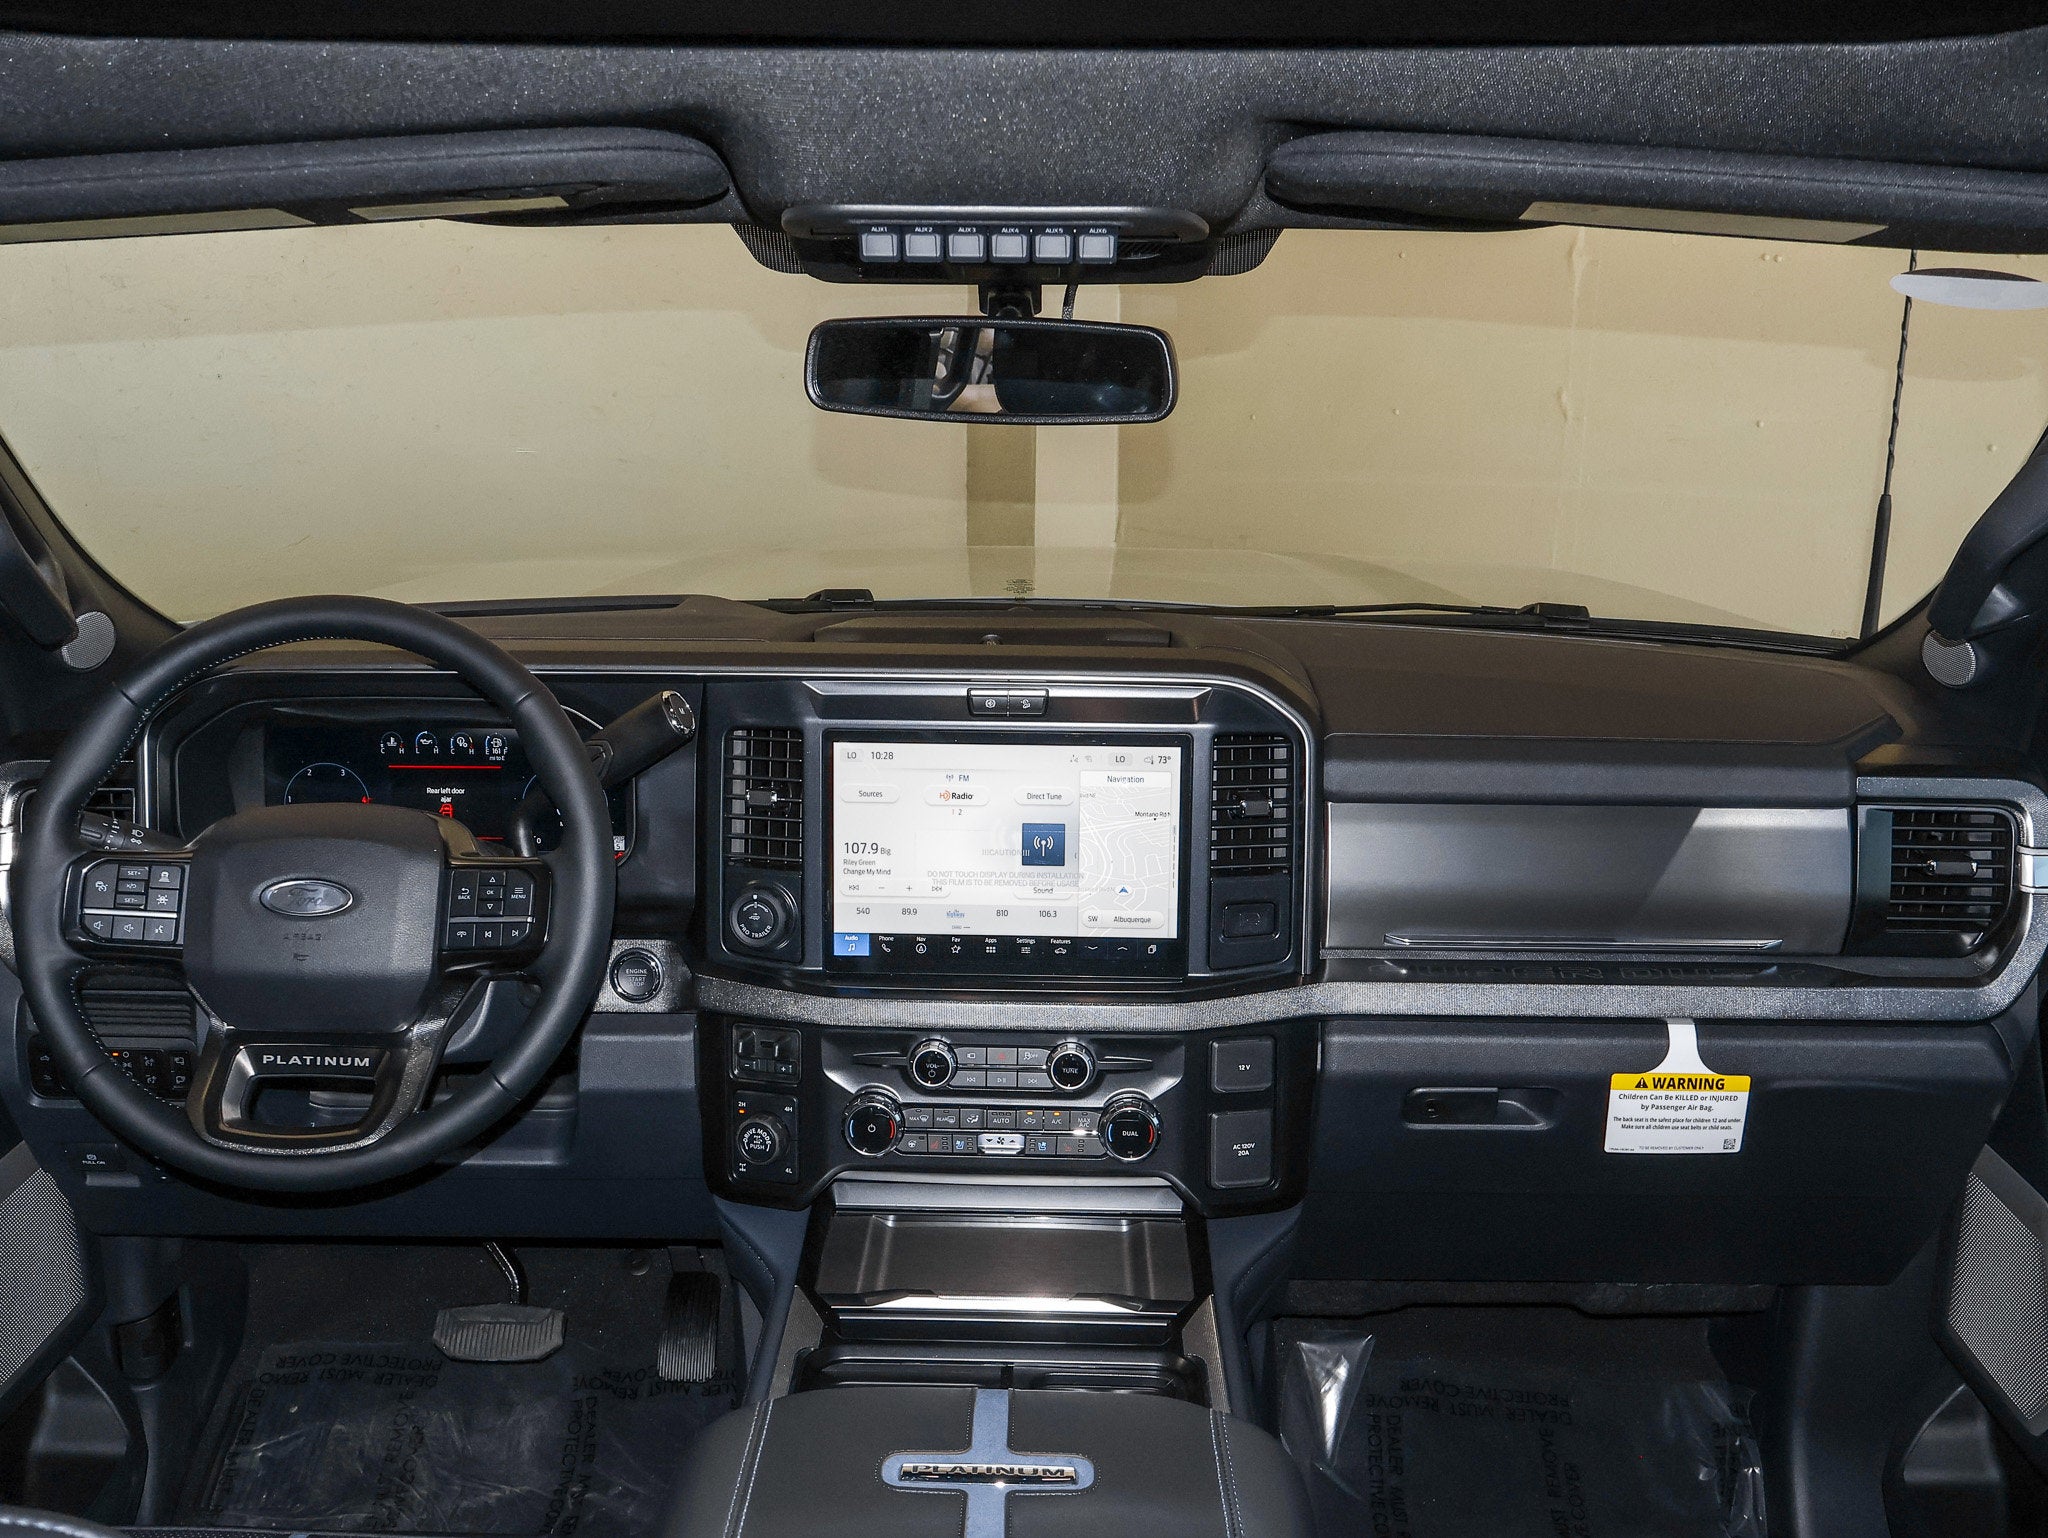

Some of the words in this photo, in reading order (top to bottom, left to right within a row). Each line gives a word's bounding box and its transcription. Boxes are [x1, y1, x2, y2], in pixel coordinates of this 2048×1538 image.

[870, 751, 894, 760] 10:28
[1115, 755, 1126, 763] LO
[307, 768, 312, 776] 2
[340, 768, 345, 776] 3
[1107, 775, 1145, 784] Navigation
[858, 790, 883, 798] Sources
[1026, 792, 1045, 800] Direct
[1046, 792, 1062, 800] Tune
[844, 842, 879, 855] 107.9
[880, 848, 891, 856] Big
[843, 858, 858, 867] Riley
[858, 858, 876, 866] Green
[843, 868, 866, 876] Change
[866, 868, 875, 876] My
[876, 868, 892, 876] Mind
[856, 907, 870, 915] 540
[901, 908, 918, 916] 89.9
[1039, 910, 1058, 918] 106.3
[1114, 916, 1152, 924] Albuquerque
[752, 925, 772, 938] TRAILER
[262, 1054, 370, 1067] PLATINUM
[1652, 1077, 1725, 1091] WARNING
[1650, 1104, 1686, 1112] Passenger
[1699, 1104, 1714, 1112] Bag.
[276, 1352, 337, 1369] COVER
[341, 1353, 444, 1373] PROTECTIVE
[373, 1370, 439, 1389] DEALER
[1400, 1377, 1461, 1398] COVER
[1465, 1384, 1571, 1408] PROTECTIVE
[1366, 1393, 1442, 1413] REMOVE
[1505, 1407, 1573, 1427] DEALER
[1387, 1414, 1404, 1477] DEALER
[1367, 1413, 1386, 1508] PROTECTIVE
[912, 1464, 1065, 1477] PLATINUM
